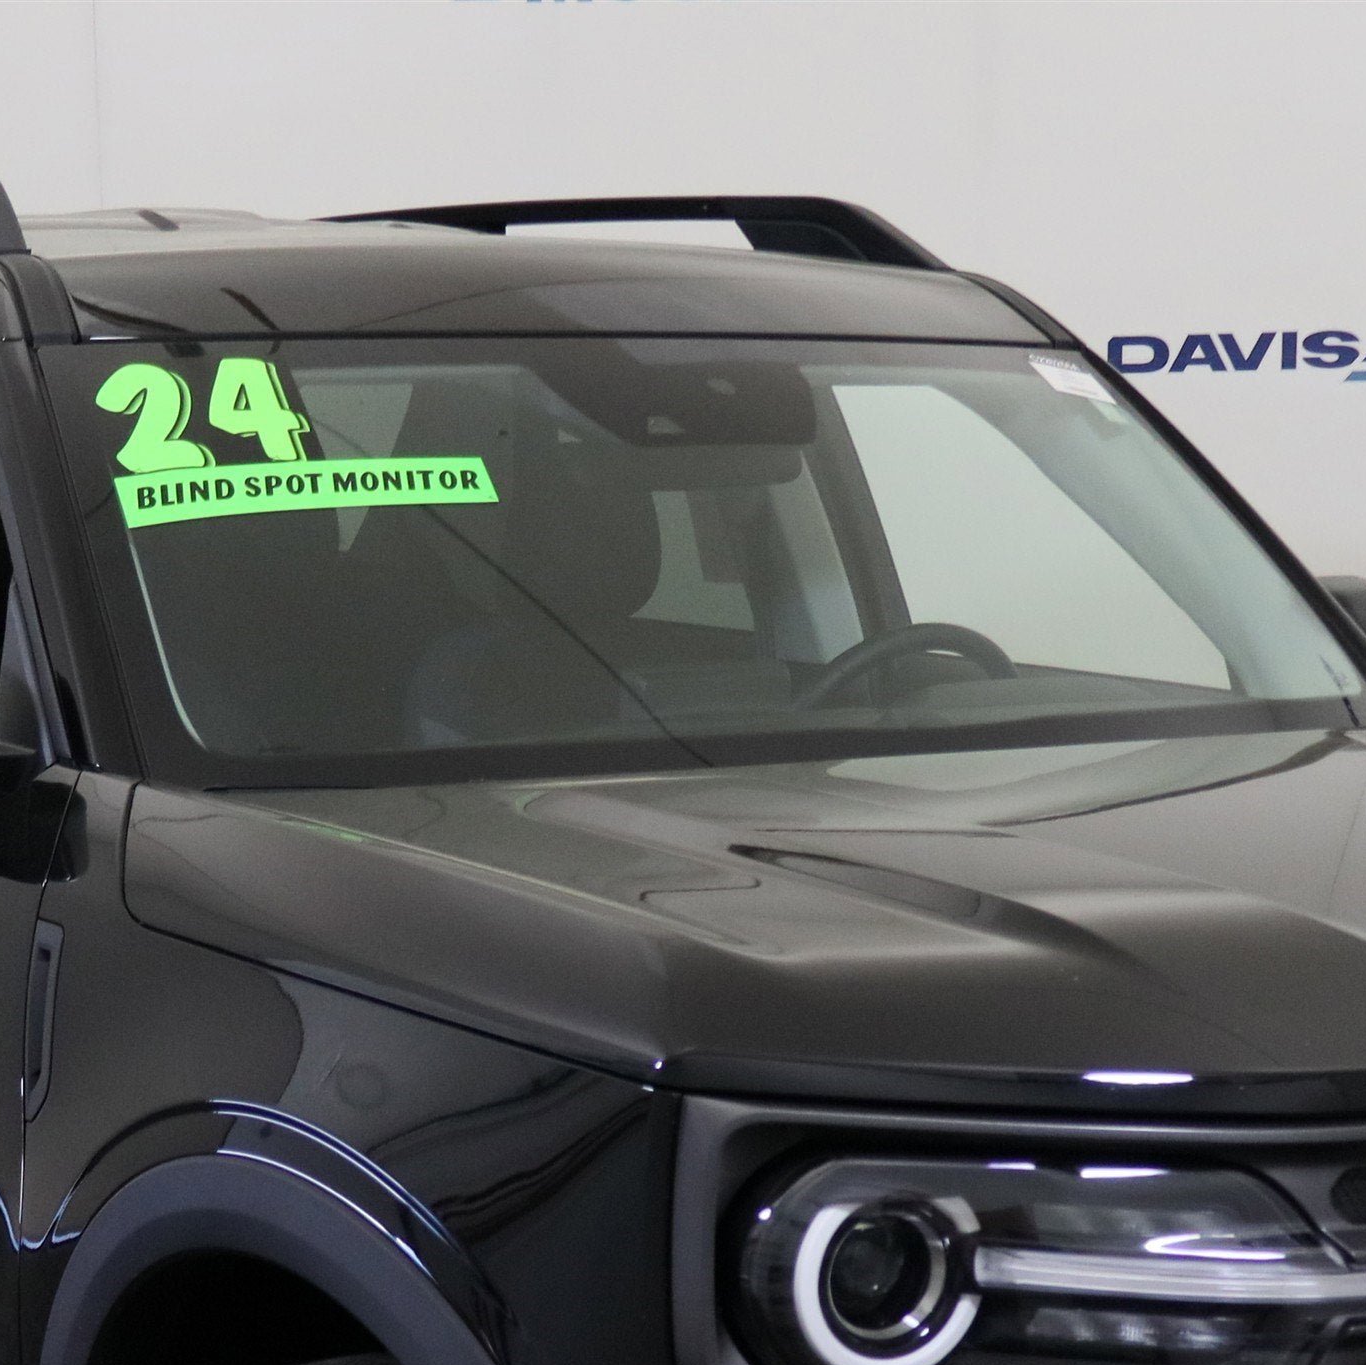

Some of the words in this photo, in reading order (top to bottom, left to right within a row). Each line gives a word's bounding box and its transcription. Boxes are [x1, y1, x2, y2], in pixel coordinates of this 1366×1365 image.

[1107, 331, 1359, 374] DAVIS
[95, 358, 311, 472] 24
[137, 478, 235, 510] BLIND
[245, 472, 323, 499] SPOT
[332, 469, 481, 493] MONITOR
